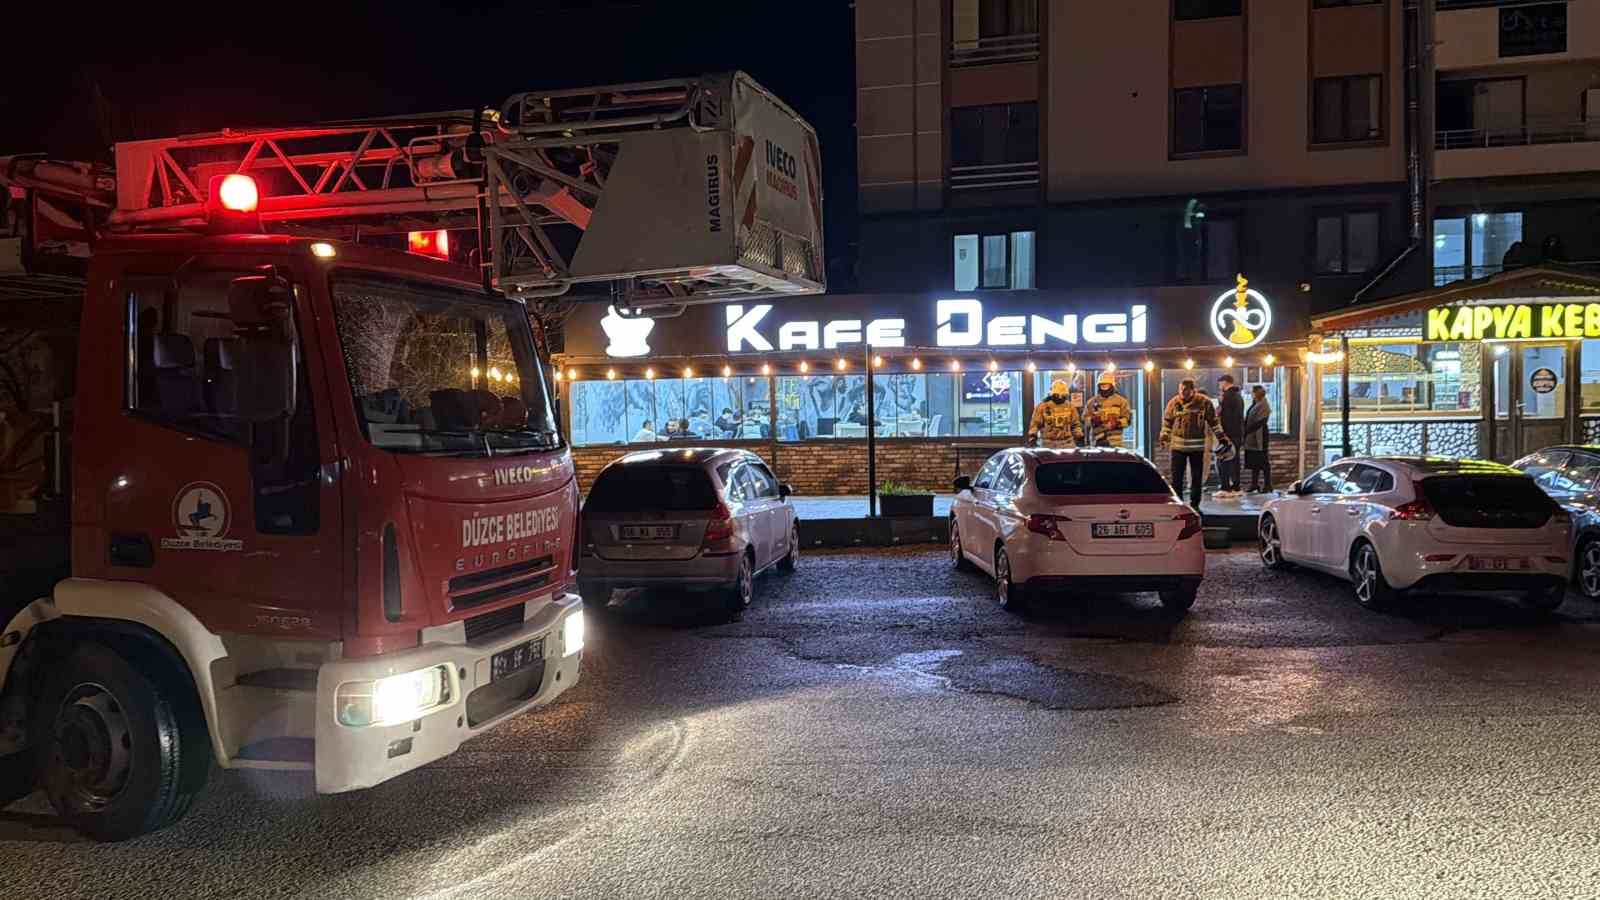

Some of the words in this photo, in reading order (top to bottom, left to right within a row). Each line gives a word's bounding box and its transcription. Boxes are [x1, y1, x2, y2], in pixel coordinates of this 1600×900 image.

[766, 139, 796, 179] IVECO
[706, 153, 720, 232] MAGIRUS
[726, 304, 905, 351] KAFE
[1427, 304, 1532, 341] KAPYA
[1541, 303, 1600, 337] KEB
[494, 466, 532, 486] IVECO
[462, 511, 505, 549] DÜZCE
